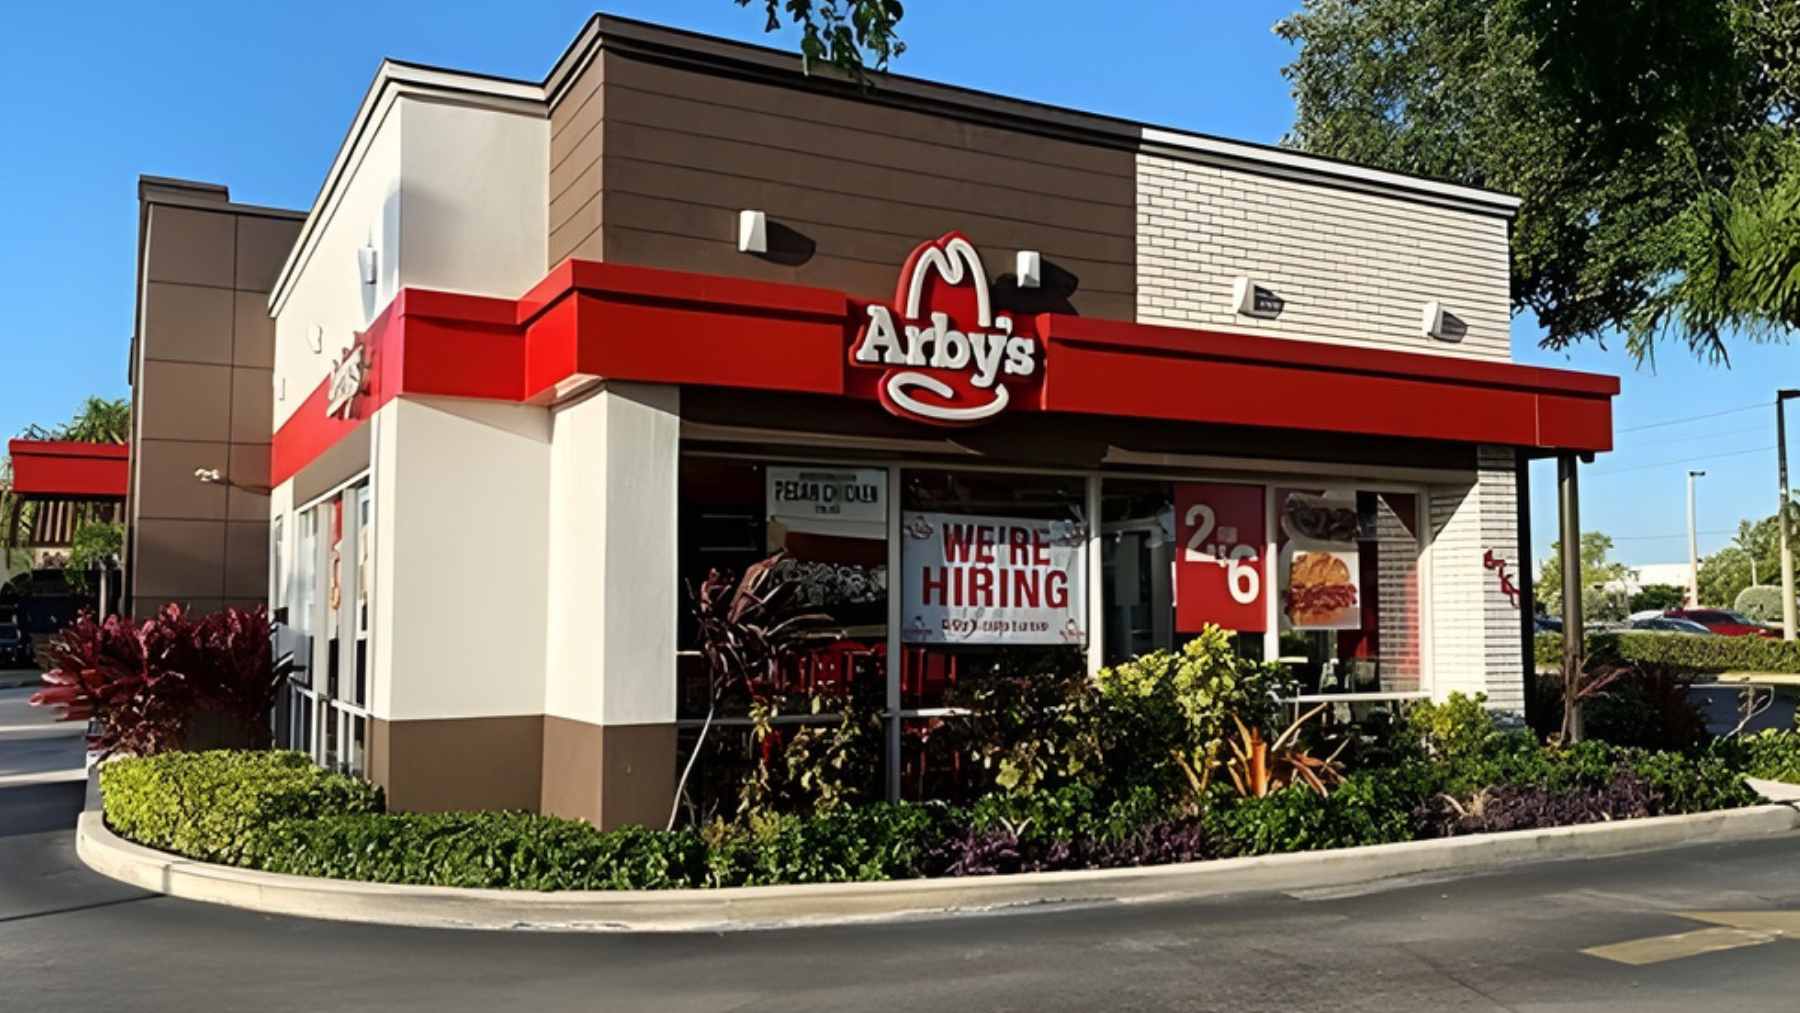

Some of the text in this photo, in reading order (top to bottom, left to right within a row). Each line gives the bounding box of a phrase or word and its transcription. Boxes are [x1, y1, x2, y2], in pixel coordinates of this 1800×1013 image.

[856, 304, 1036, 388] Arby's
[943, 523, 1051, 566] WE'RE
[1185, 504, 1260, 605] 2 6
[922, 566, 1068, 609] HIRING
